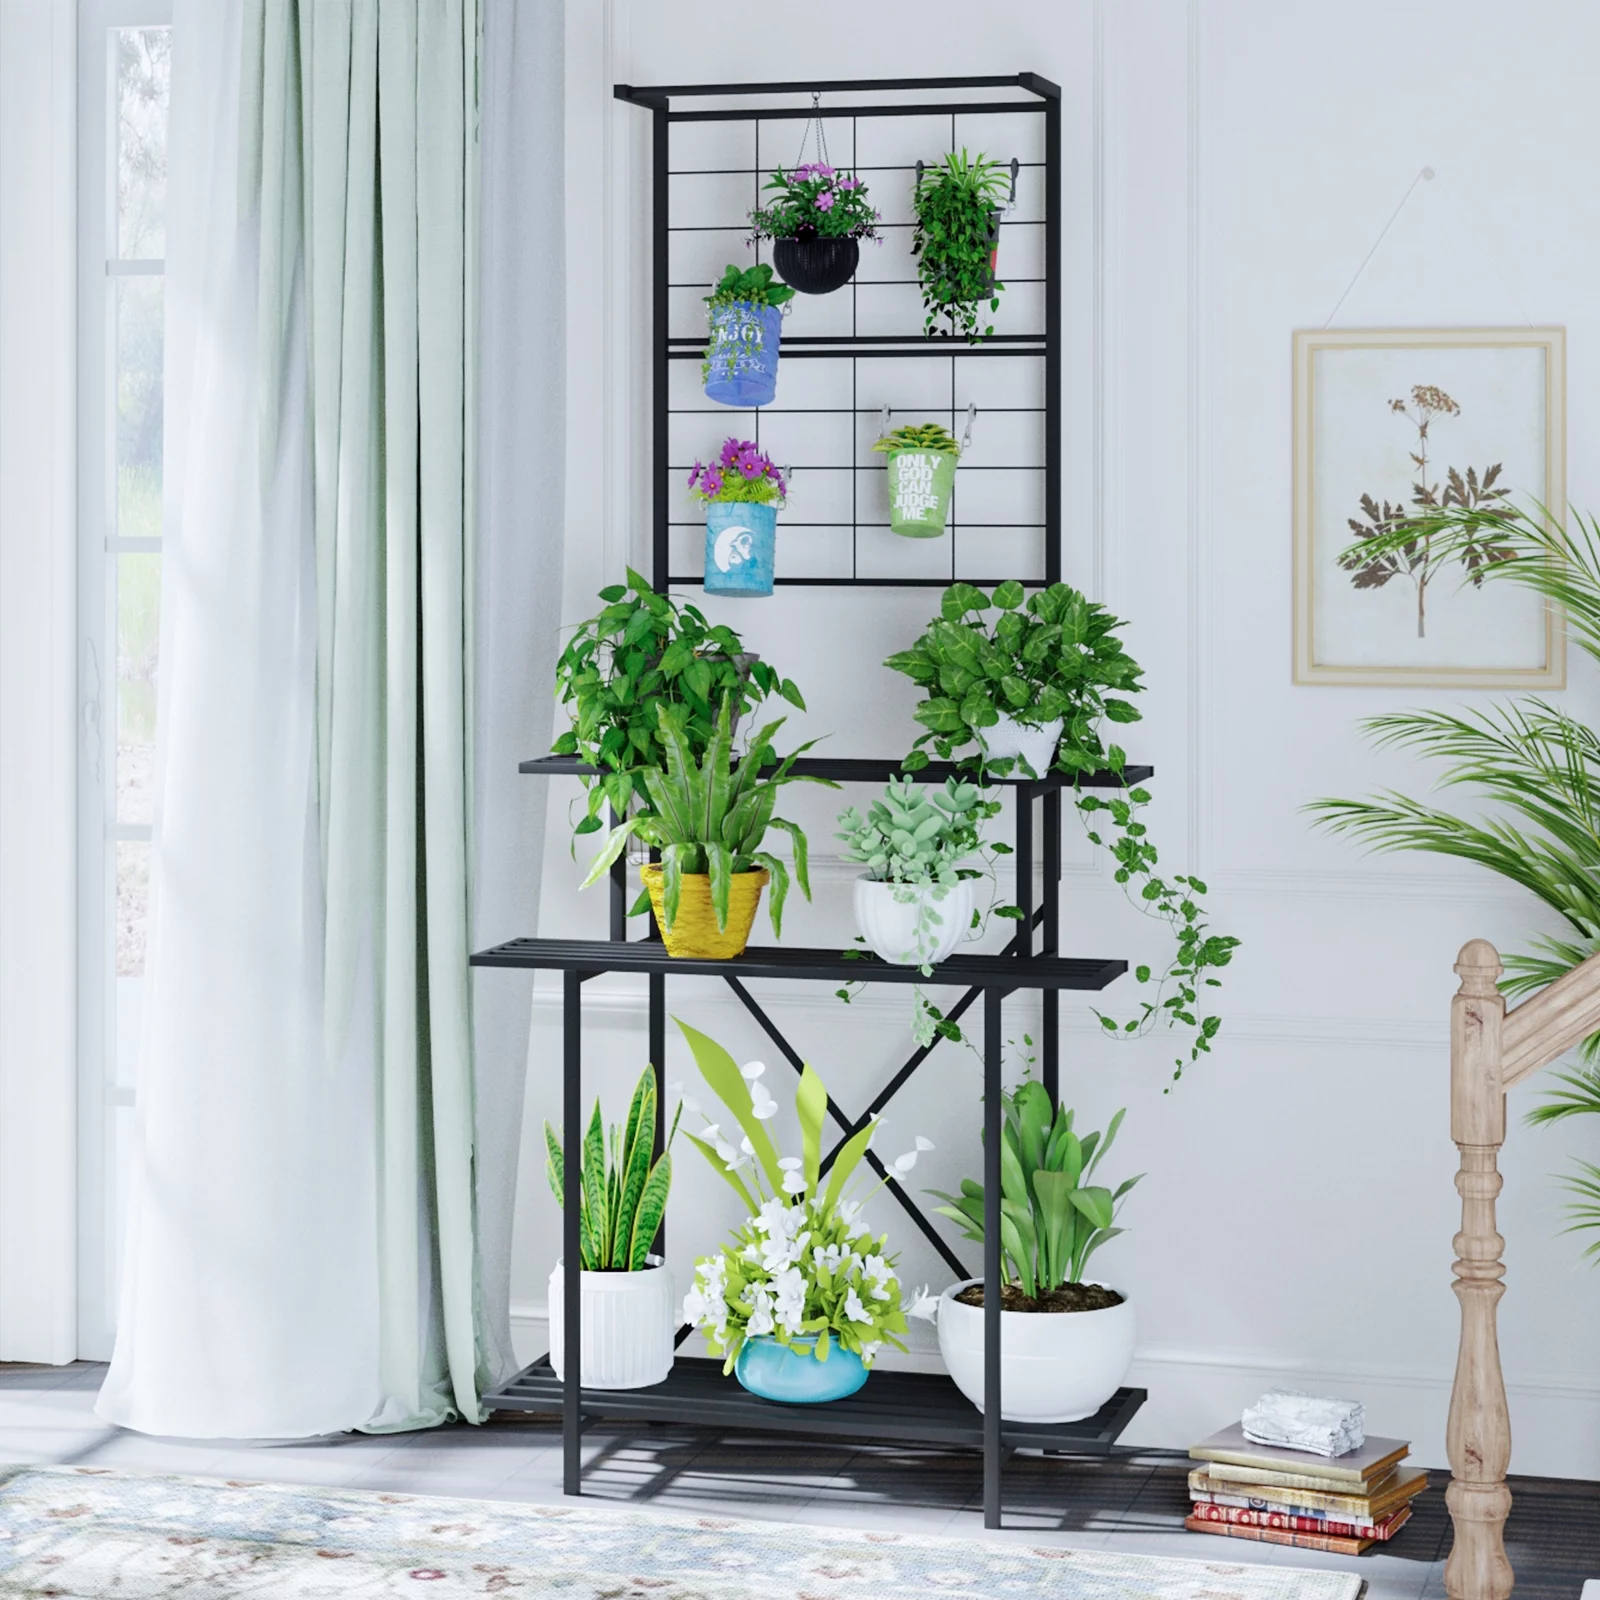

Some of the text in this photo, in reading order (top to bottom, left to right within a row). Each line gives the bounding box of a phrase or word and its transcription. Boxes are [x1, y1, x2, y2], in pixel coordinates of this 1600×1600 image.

[712, 324, 763, 345] NJOY
[897, 454, 941, 469] ONLY
[898, 467, 933, 481] GOD
[898, 480, 931, 494] CAN
[893, 493, 938, 509] JUDGE
[902, 507, 928, 520] ME.
